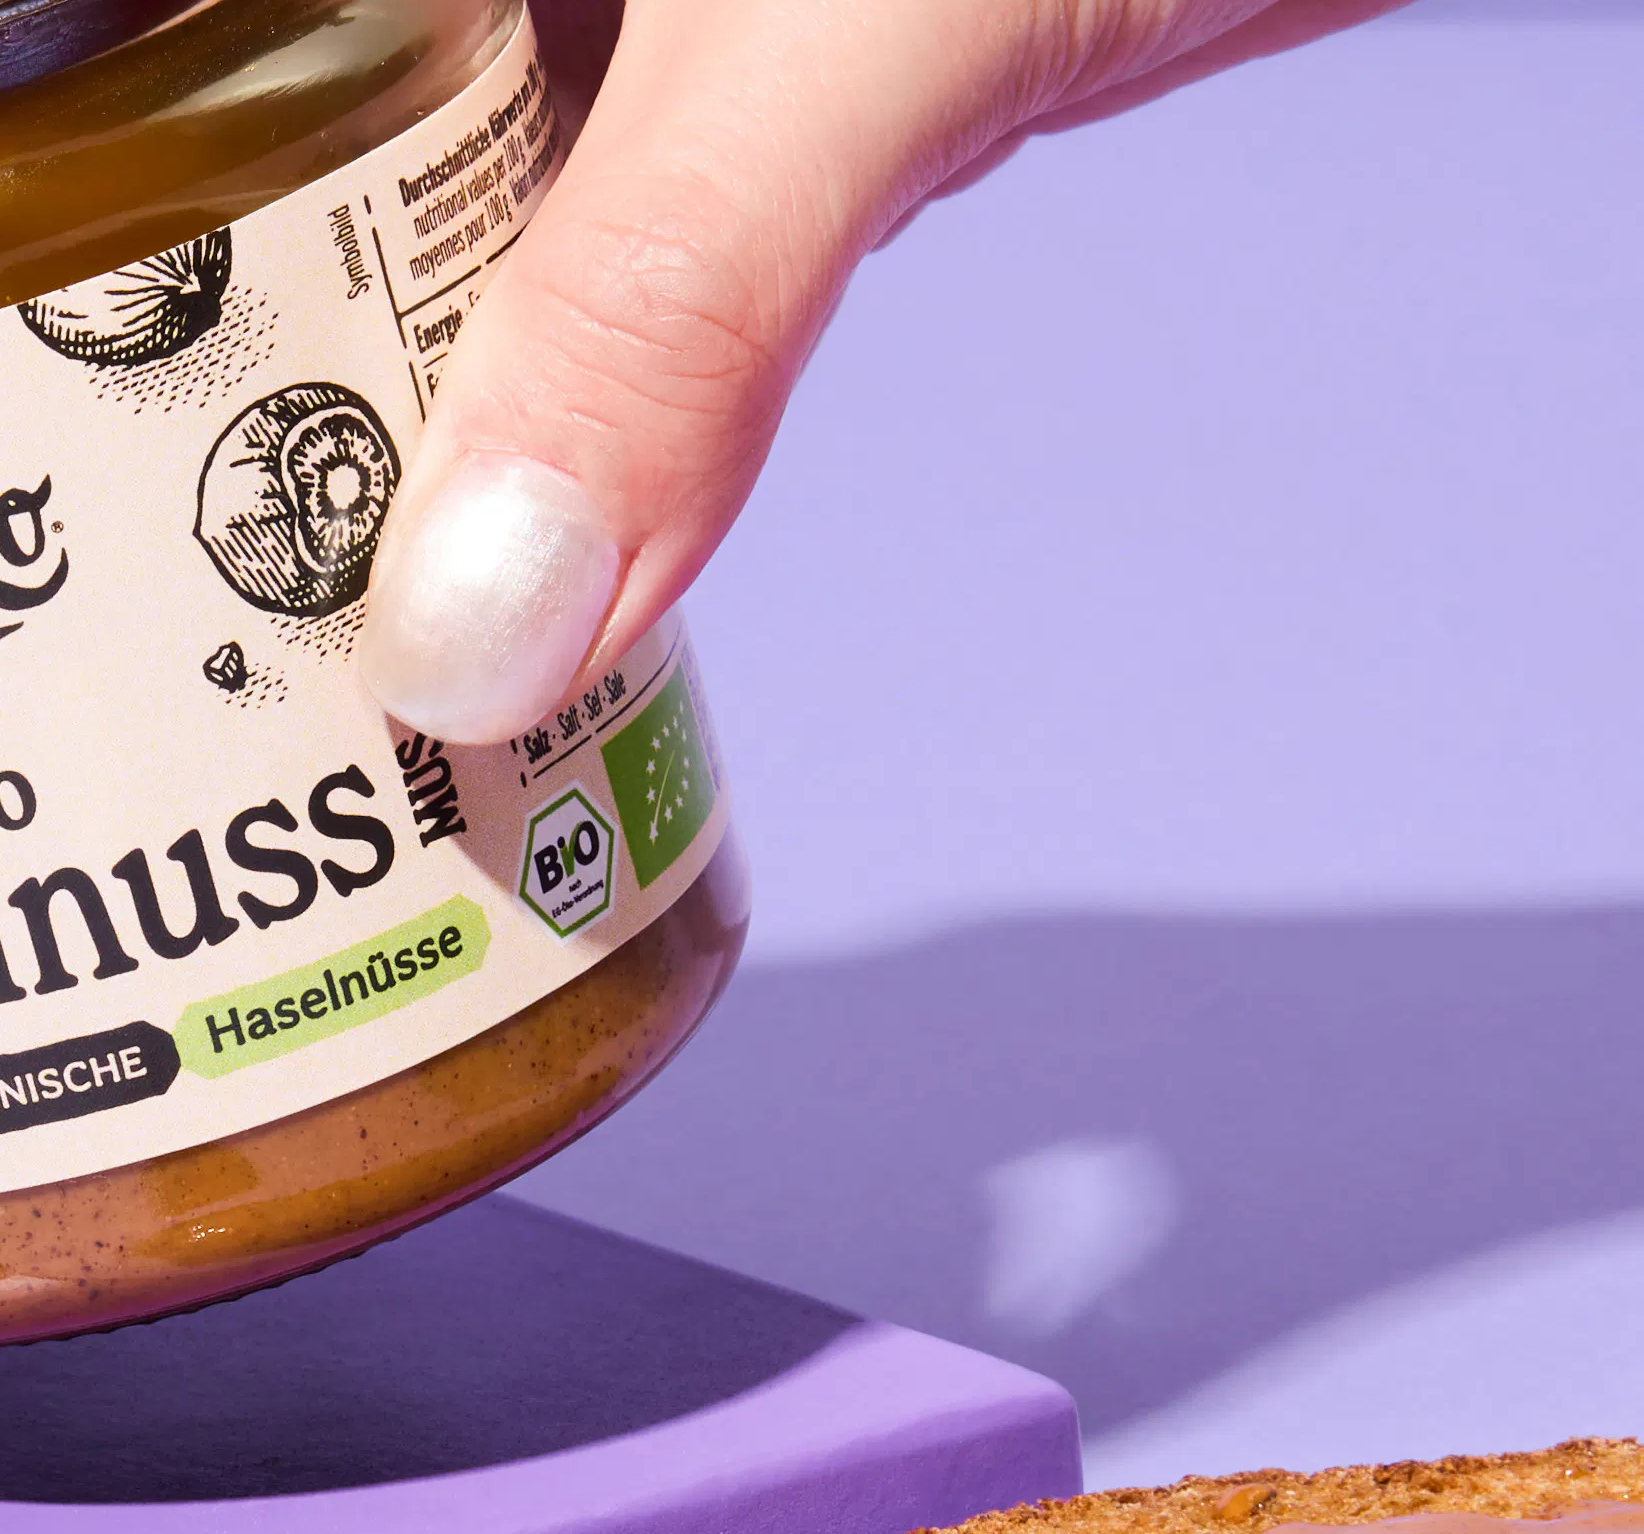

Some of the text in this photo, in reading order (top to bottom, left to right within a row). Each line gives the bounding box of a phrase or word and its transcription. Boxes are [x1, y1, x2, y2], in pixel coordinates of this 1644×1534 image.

[398, 124, 491, 208] Durchschnittliche
[413, 179, 468, 239] nutritional
[465, 168, 495, 203] values
[492, 154, 506, 190] per
[503, 133, 519, 172] 100
[327, 203, 373, 300] Symbolbild
[409, 230, 466, 281] moyennes
[464, 212, 488, 252] pour
[485, 193, 505, 231] 100
[502, 193, 513, 223] g
[523, 669, 627, 764] Salz Salt Sel Sale
[206, 919, 463, 1054] Haselnüsse
